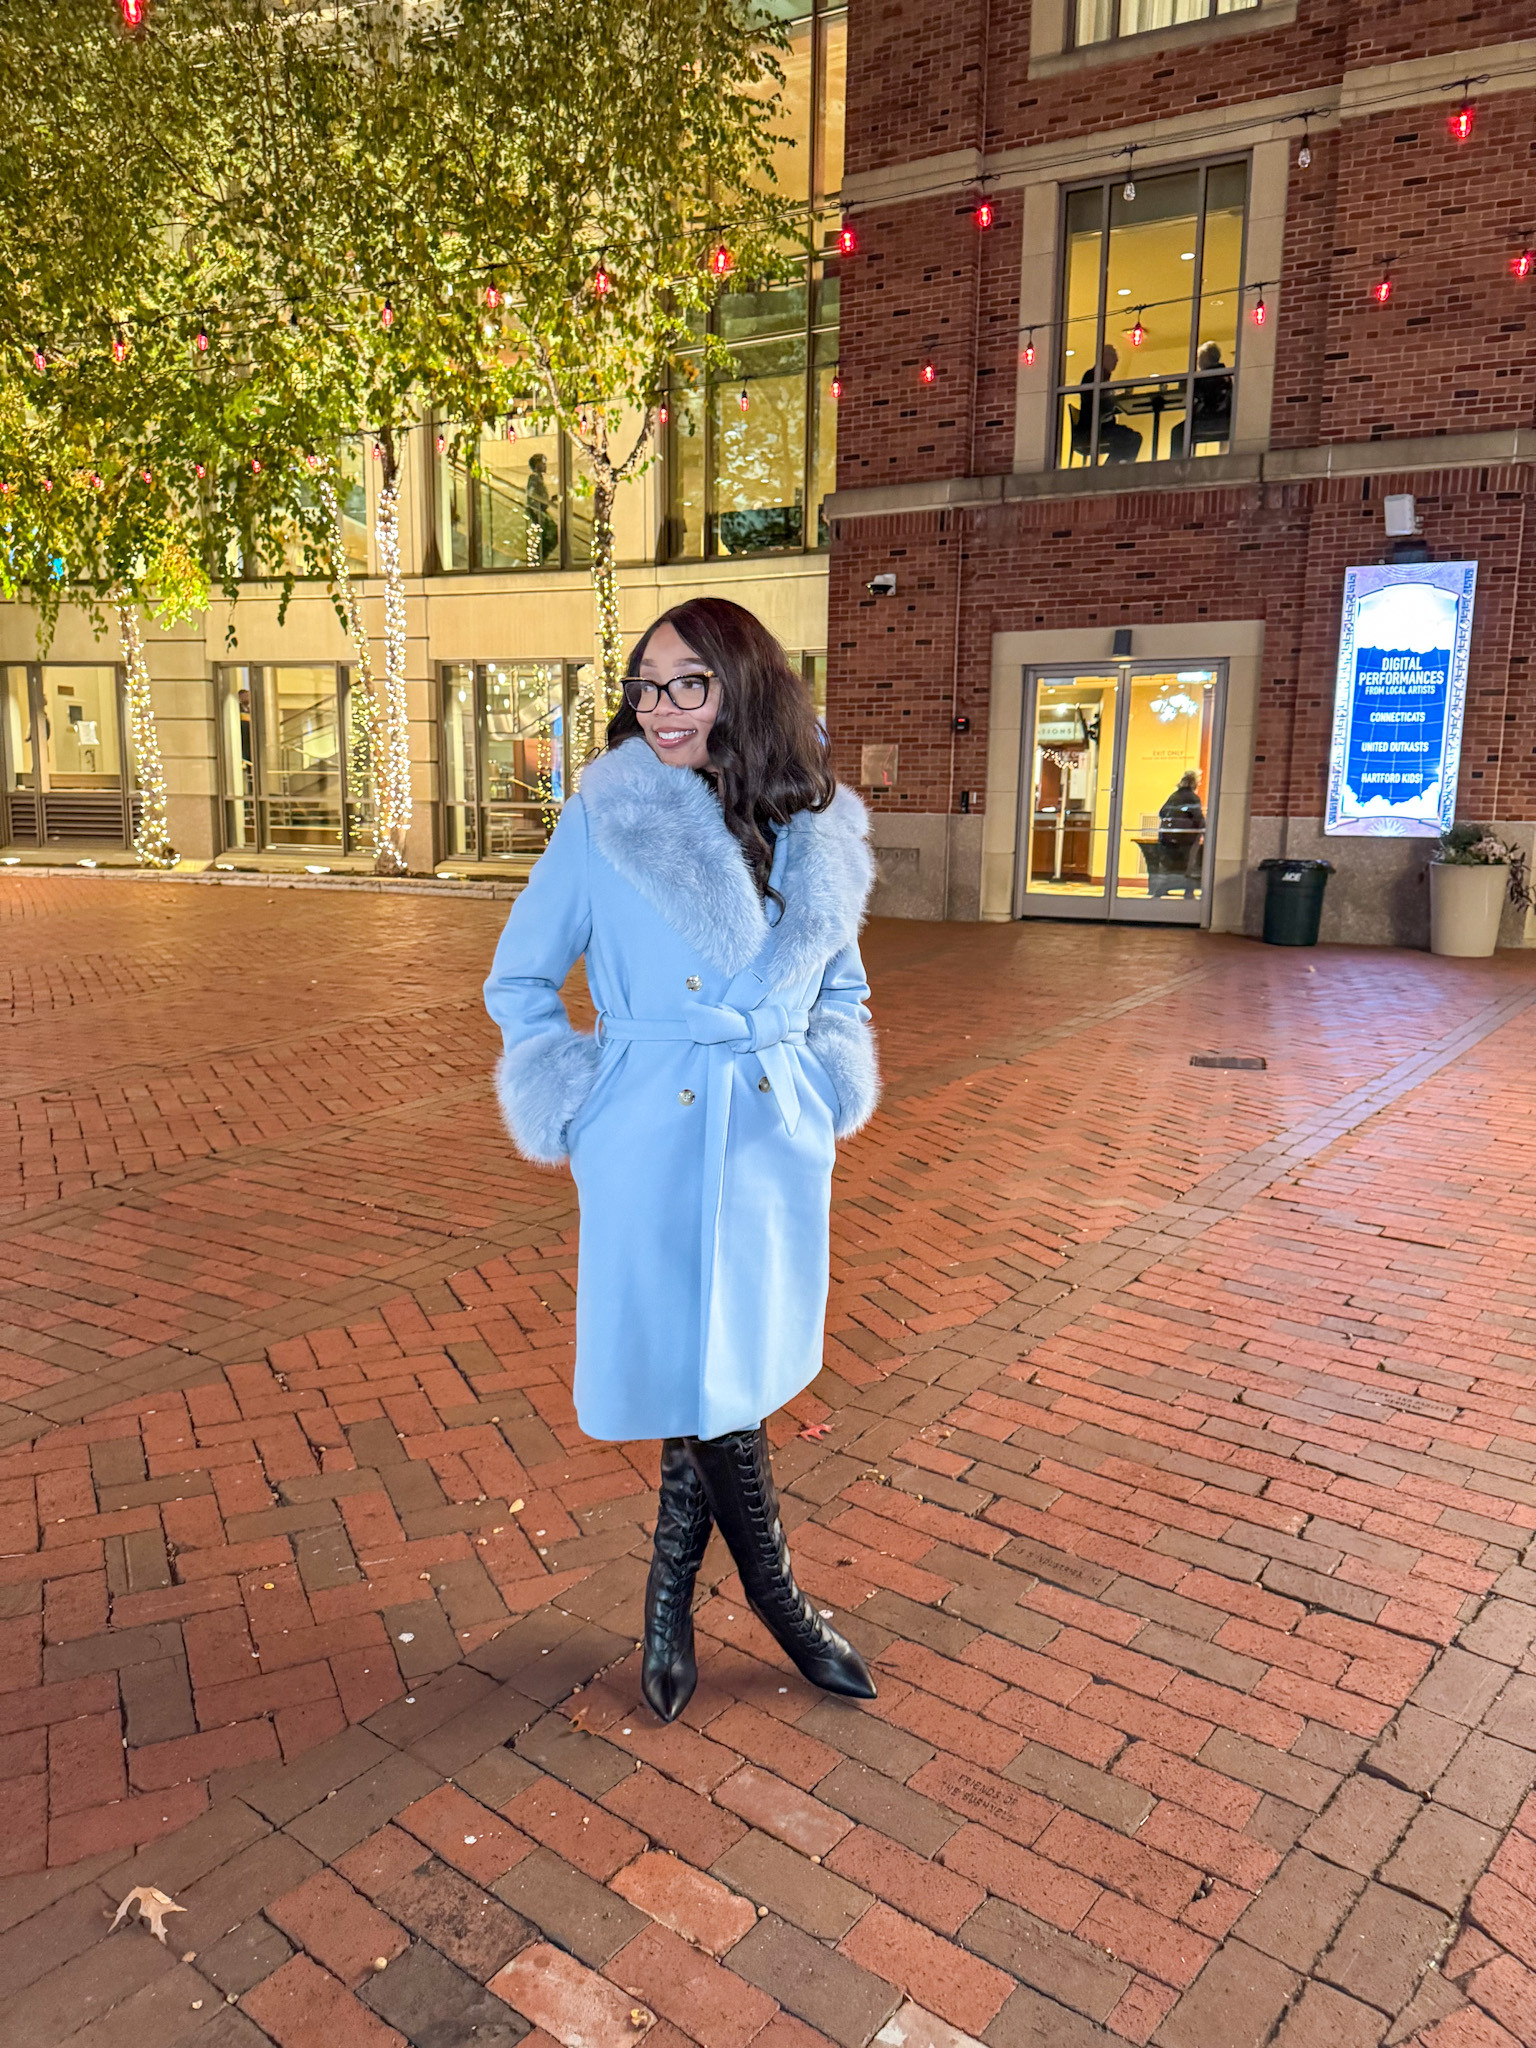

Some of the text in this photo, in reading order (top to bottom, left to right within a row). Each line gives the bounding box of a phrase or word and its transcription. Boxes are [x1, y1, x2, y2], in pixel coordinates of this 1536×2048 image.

[1381, 656, 1423, 671] DIGITAL
[1359, 670, 1444, 686] PERFORMANCES
[1365, 685, 1436, 695] FROM LOCAL ARTISTS
[1369, 711, 1426, 722] CONNECTICATS
[1361, 741, 1429, 752] UNITED OUTKASTS
[1361, 772, 1401, 783] HARTFORD
[958, 1773, 1018, 1806] FRIENDS OF
